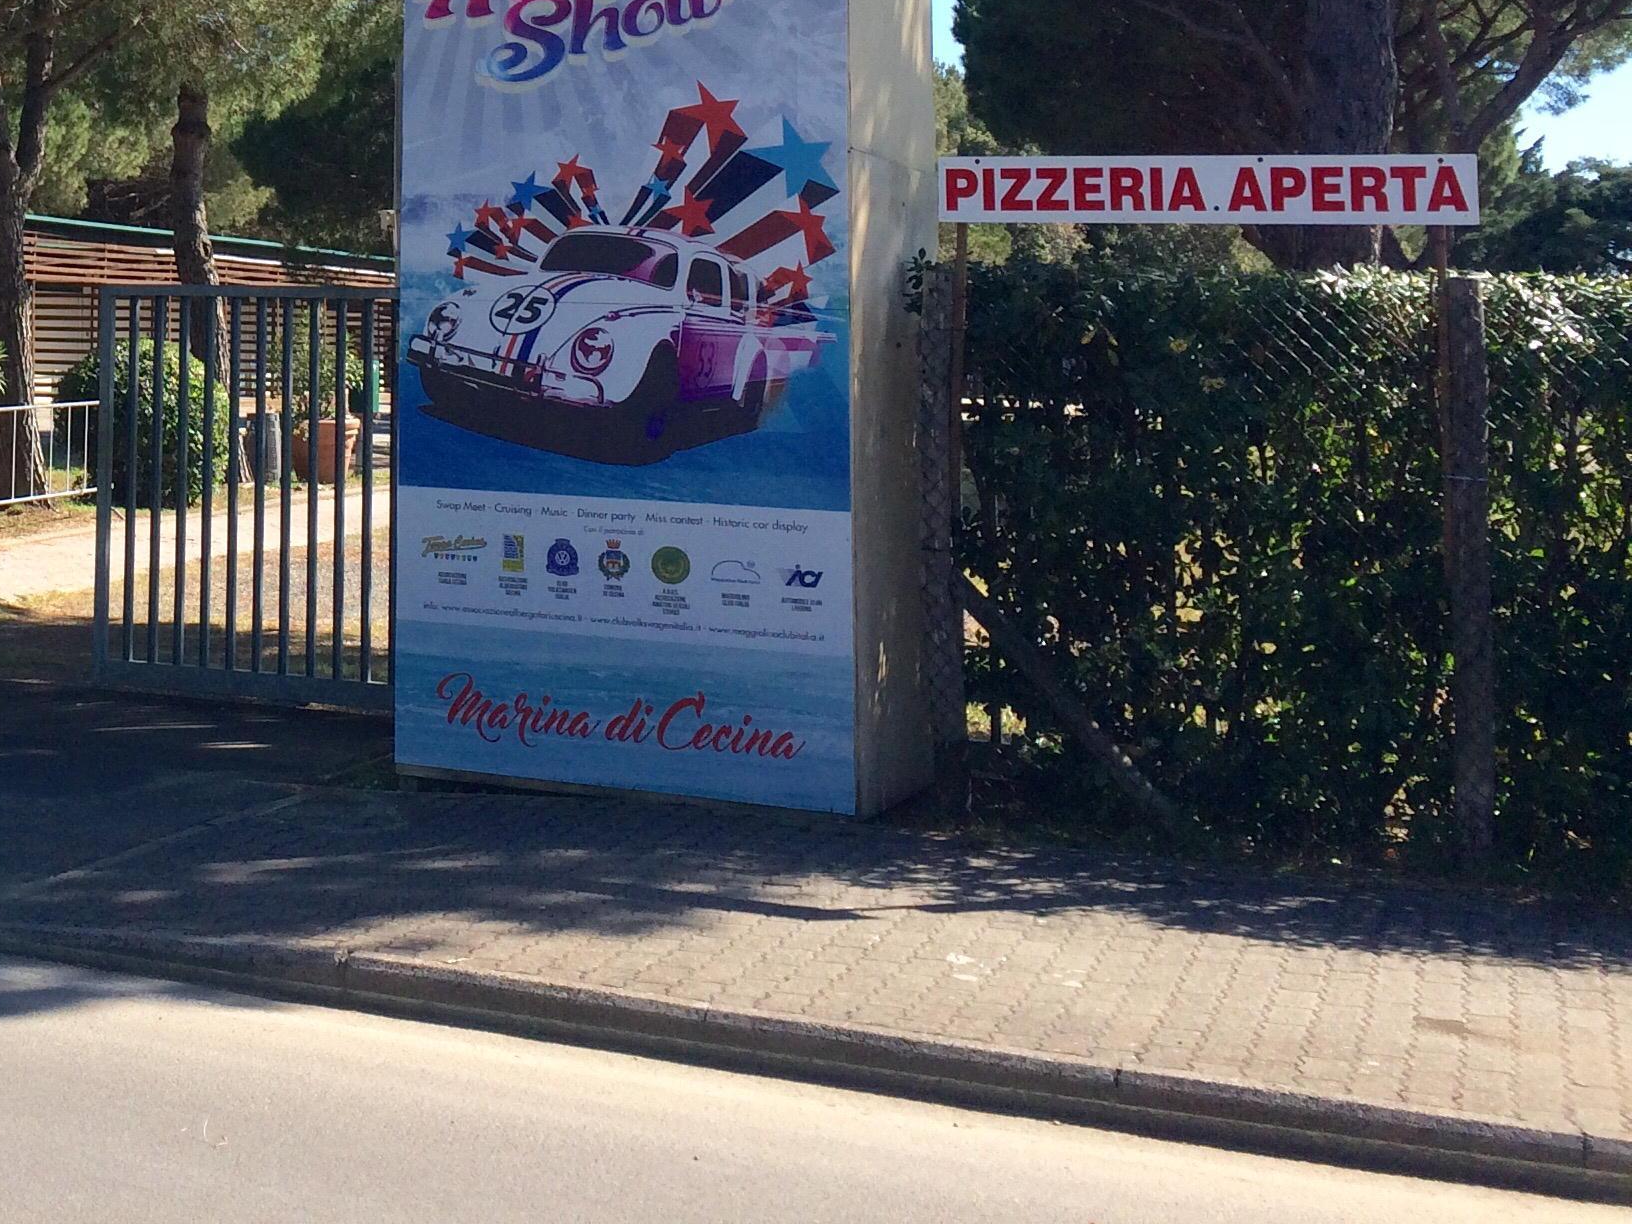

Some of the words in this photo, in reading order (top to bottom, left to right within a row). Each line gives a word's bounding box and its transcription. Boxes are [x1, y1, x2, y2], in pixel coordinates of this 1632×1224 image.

[945, 167, 1207, 211] PIZZERIA
[1228, 165, 1469, 212] APERTA
[495, 292, 549, 324] 25
[436, 500, 461, 511] Swap
[463, 502, 486, 511] Meet
[494, 503, 532, 516] Cruising
[541, 507, 568, 517] Music
[577, 509, 608, 520] Dinner
[611, 513, 636, 524] party
[645, 513, 667, 523] Miss
[670, 517, 703, 526] contest
[713, 517, 750, 529] Historic
[772, 519, 809, 534] display
[436, 672, 601, 748] Marina
[604, 697, 655, 746] di
[656, 690, 806, 761] Cecina
